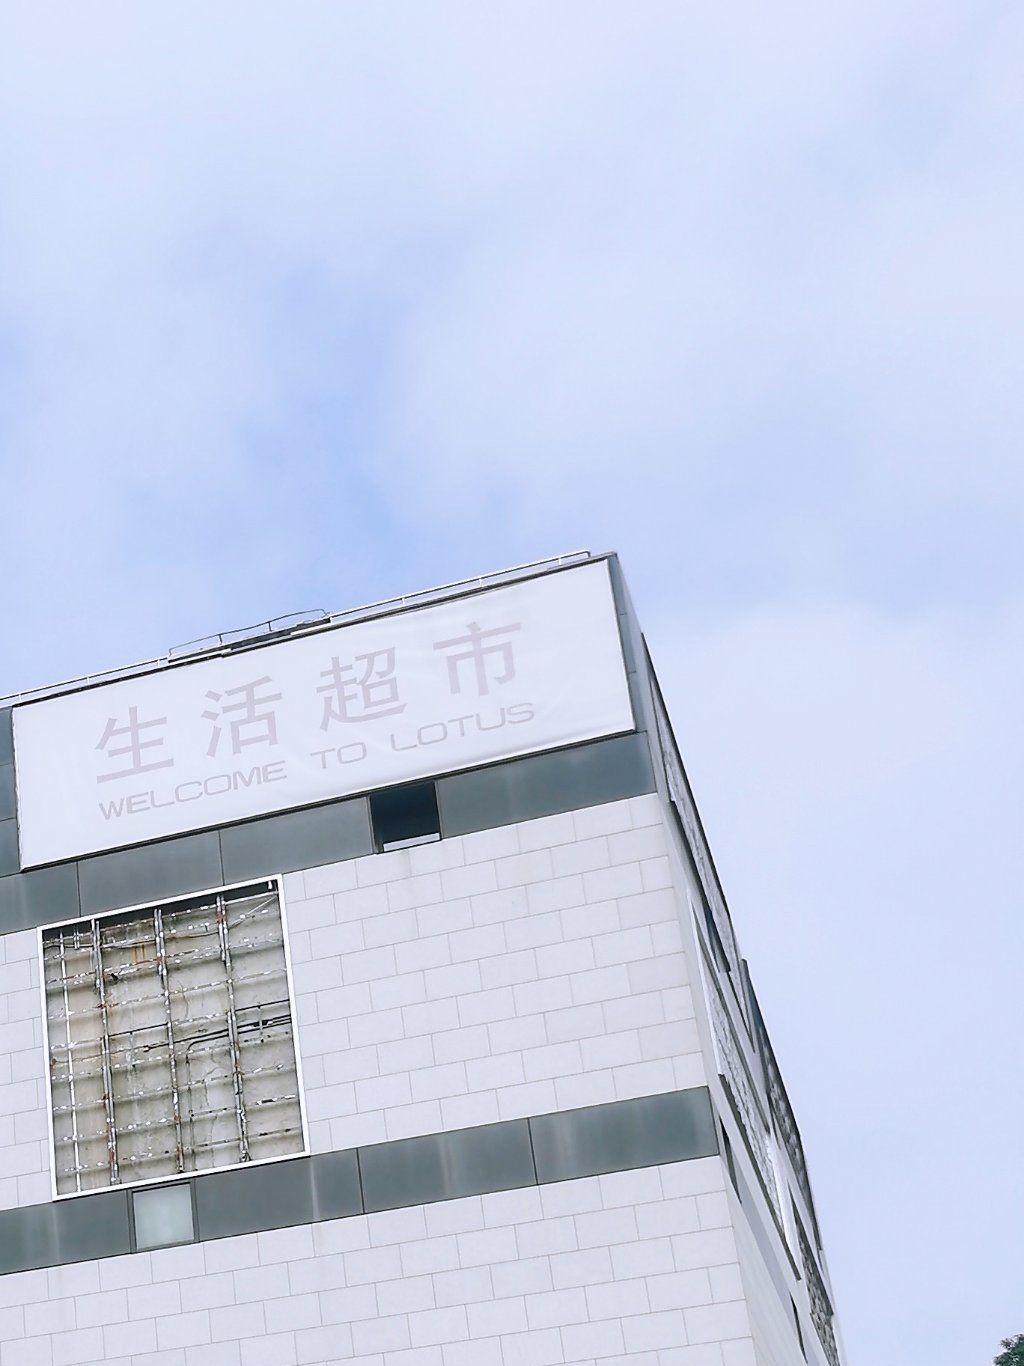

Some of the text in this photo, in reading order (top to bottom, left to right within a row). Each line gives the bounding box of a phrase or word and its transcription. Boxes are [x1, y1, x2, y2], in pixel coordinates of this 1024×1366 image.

[94, 621, 523, 785] 生活超市
[98, 702, 536, 821] WELCOME TO LOTUS
